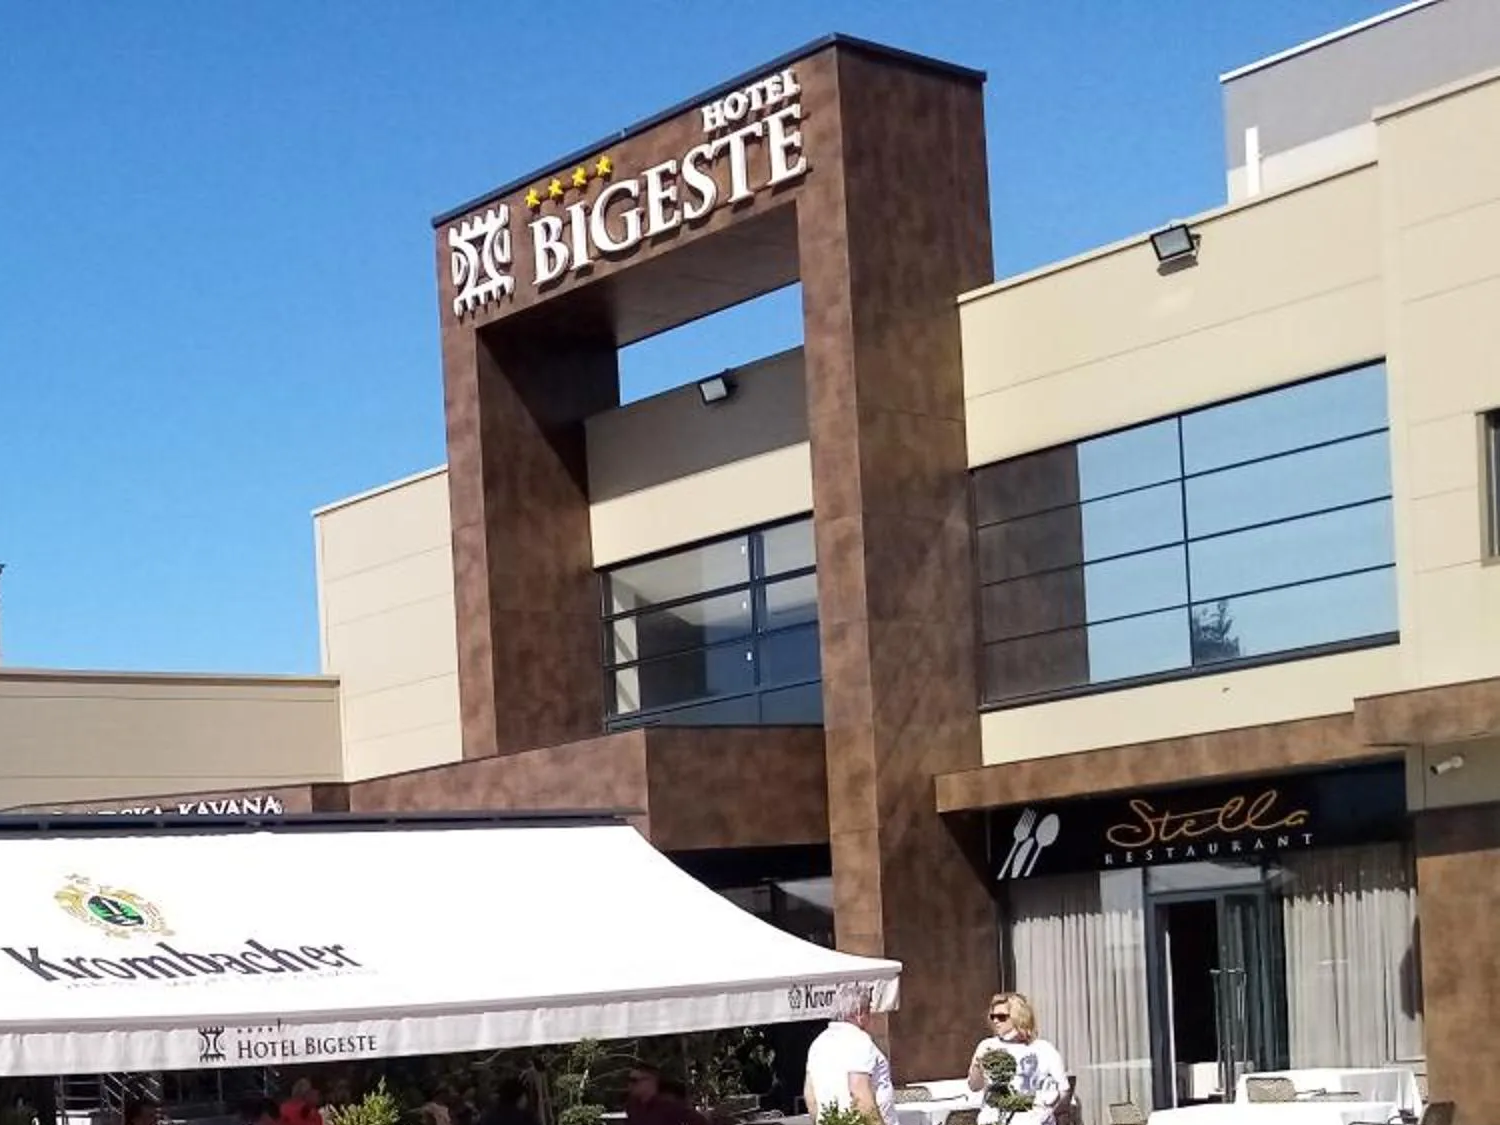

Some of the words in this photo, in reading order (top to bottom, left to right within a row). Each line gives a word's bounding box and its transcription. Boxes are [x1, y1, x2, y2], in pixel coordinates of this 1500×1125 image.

[702, 69, 800, 133] HOTEL
[529, 103, 807, 287] BIGESTE
[1106, 789, 1310, 848] Stella
[1104, 833, 1313, 865] RESTAURANT
[1, 939, 363, 981] Krombacher
[237, 1038, 299, 1060] HOTEL
[306, 1034, 378, 1055] BIGESTE
